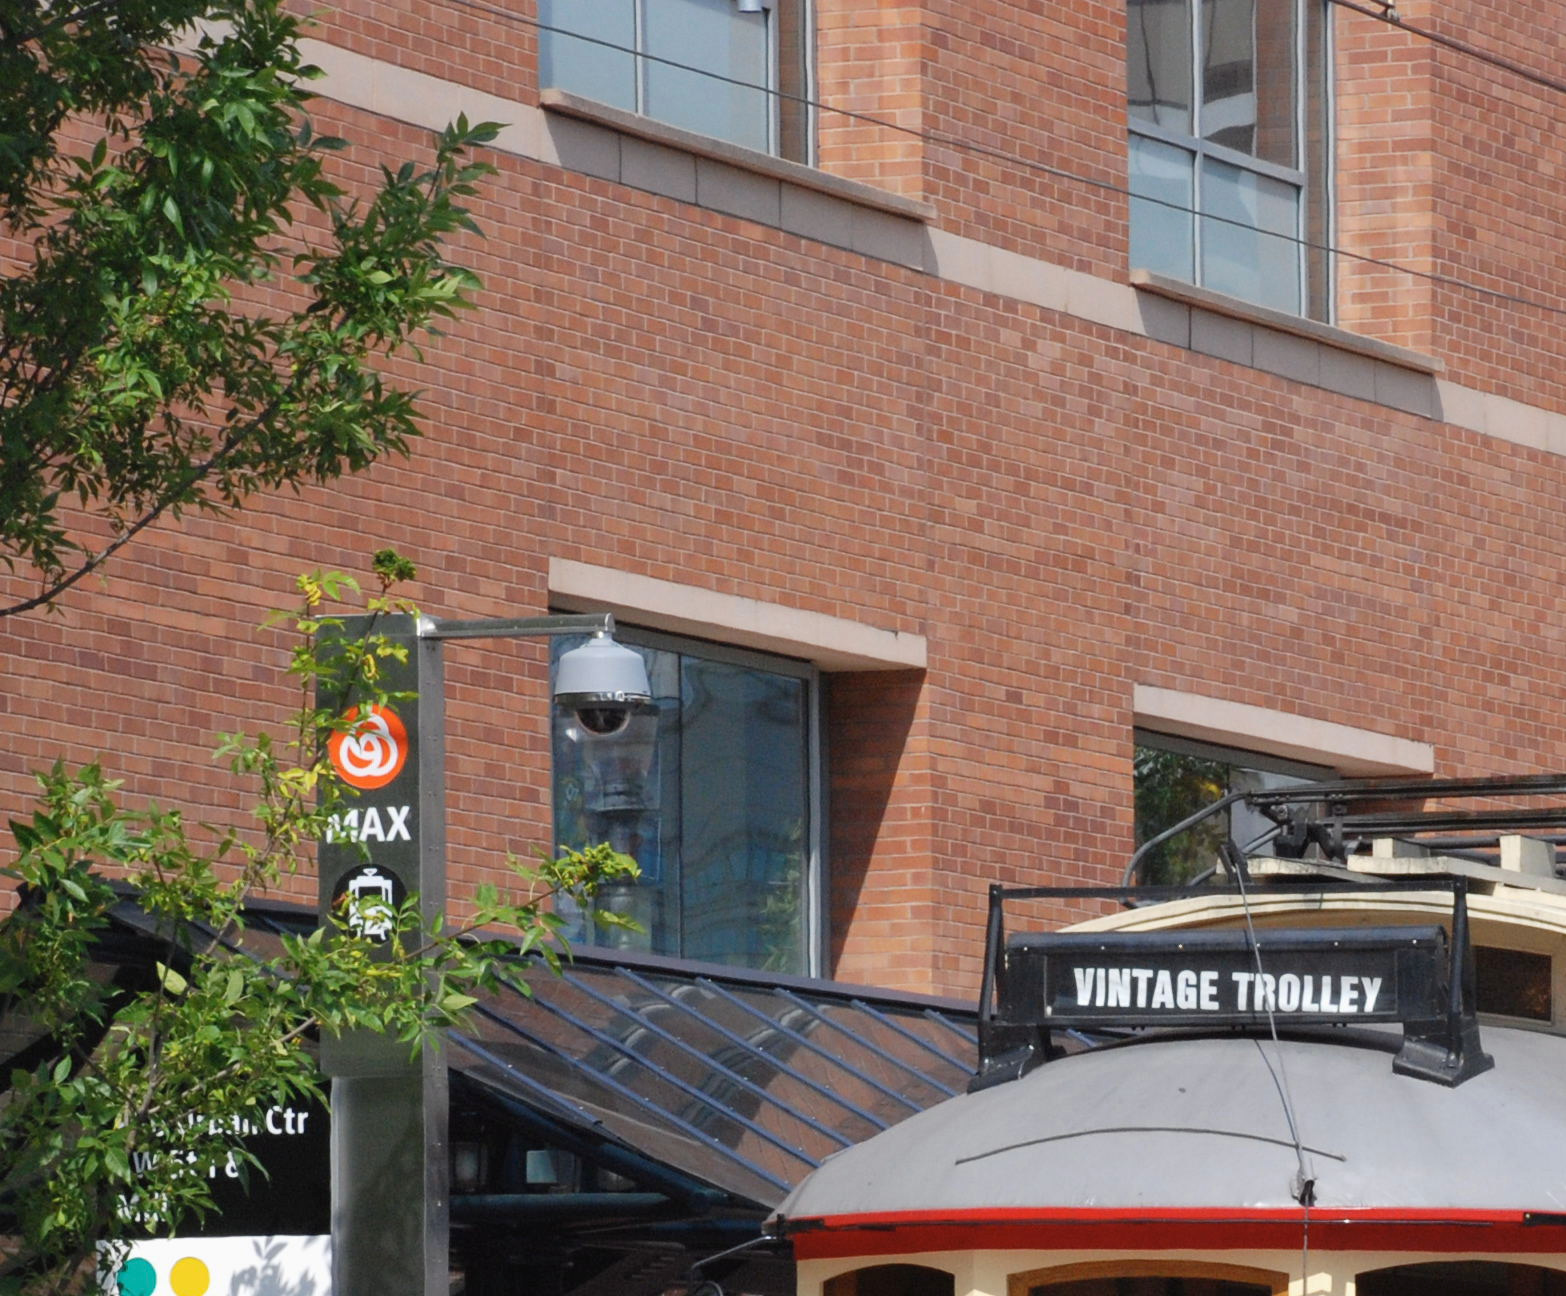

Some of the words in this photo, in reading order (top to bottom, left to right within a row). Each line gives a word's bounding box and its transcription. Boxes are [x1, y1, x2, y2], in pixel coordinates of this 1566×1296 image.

[326, 806, 411, 844] MAX
[1073, 967, 1220, 1010] VINTAGE
[1231, 972, 1382, 1014] TROLLEY
[265, 1105, 309, 1135] Ctr
